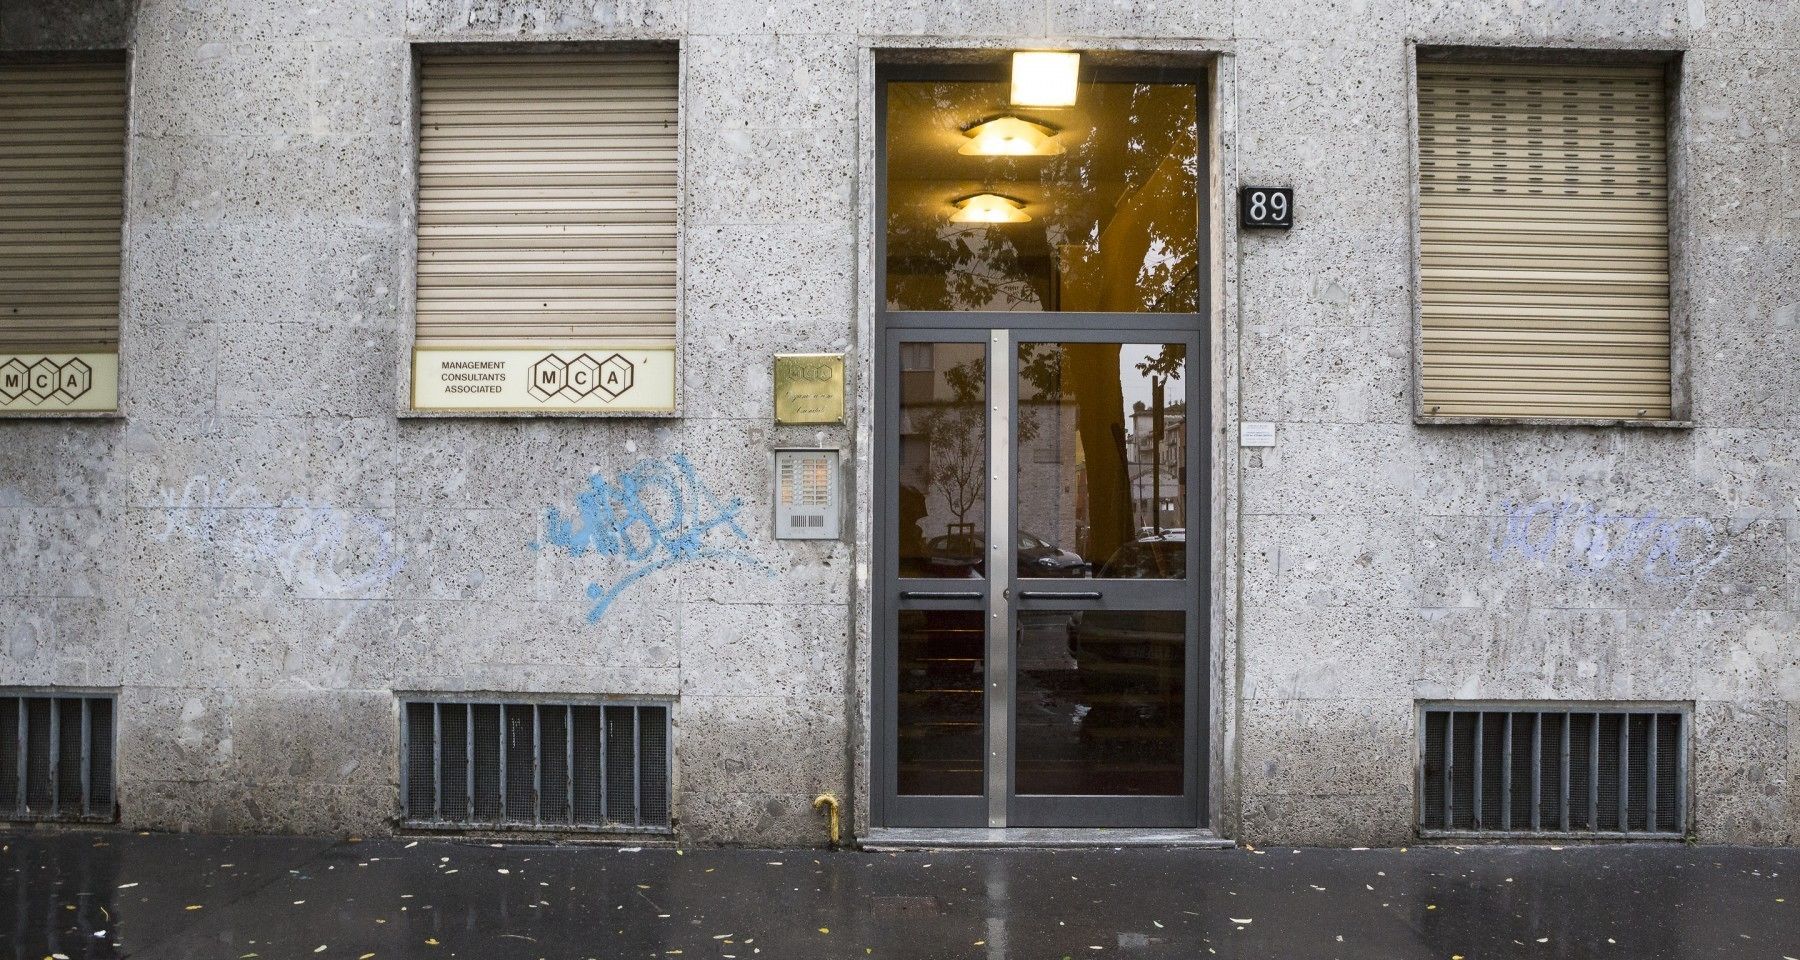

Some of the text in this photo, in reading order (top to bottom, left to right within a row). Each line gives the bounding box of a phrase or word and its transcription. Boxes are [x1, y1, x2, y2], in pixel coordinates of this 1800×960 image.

[1250, 191, 1287, 221] 89
[441, 361, 505, 370] MANAGEMENT
[441, 373, 506, 382] CONSULTANTS
[444, 385, 502, 394] ASSOCIATED
